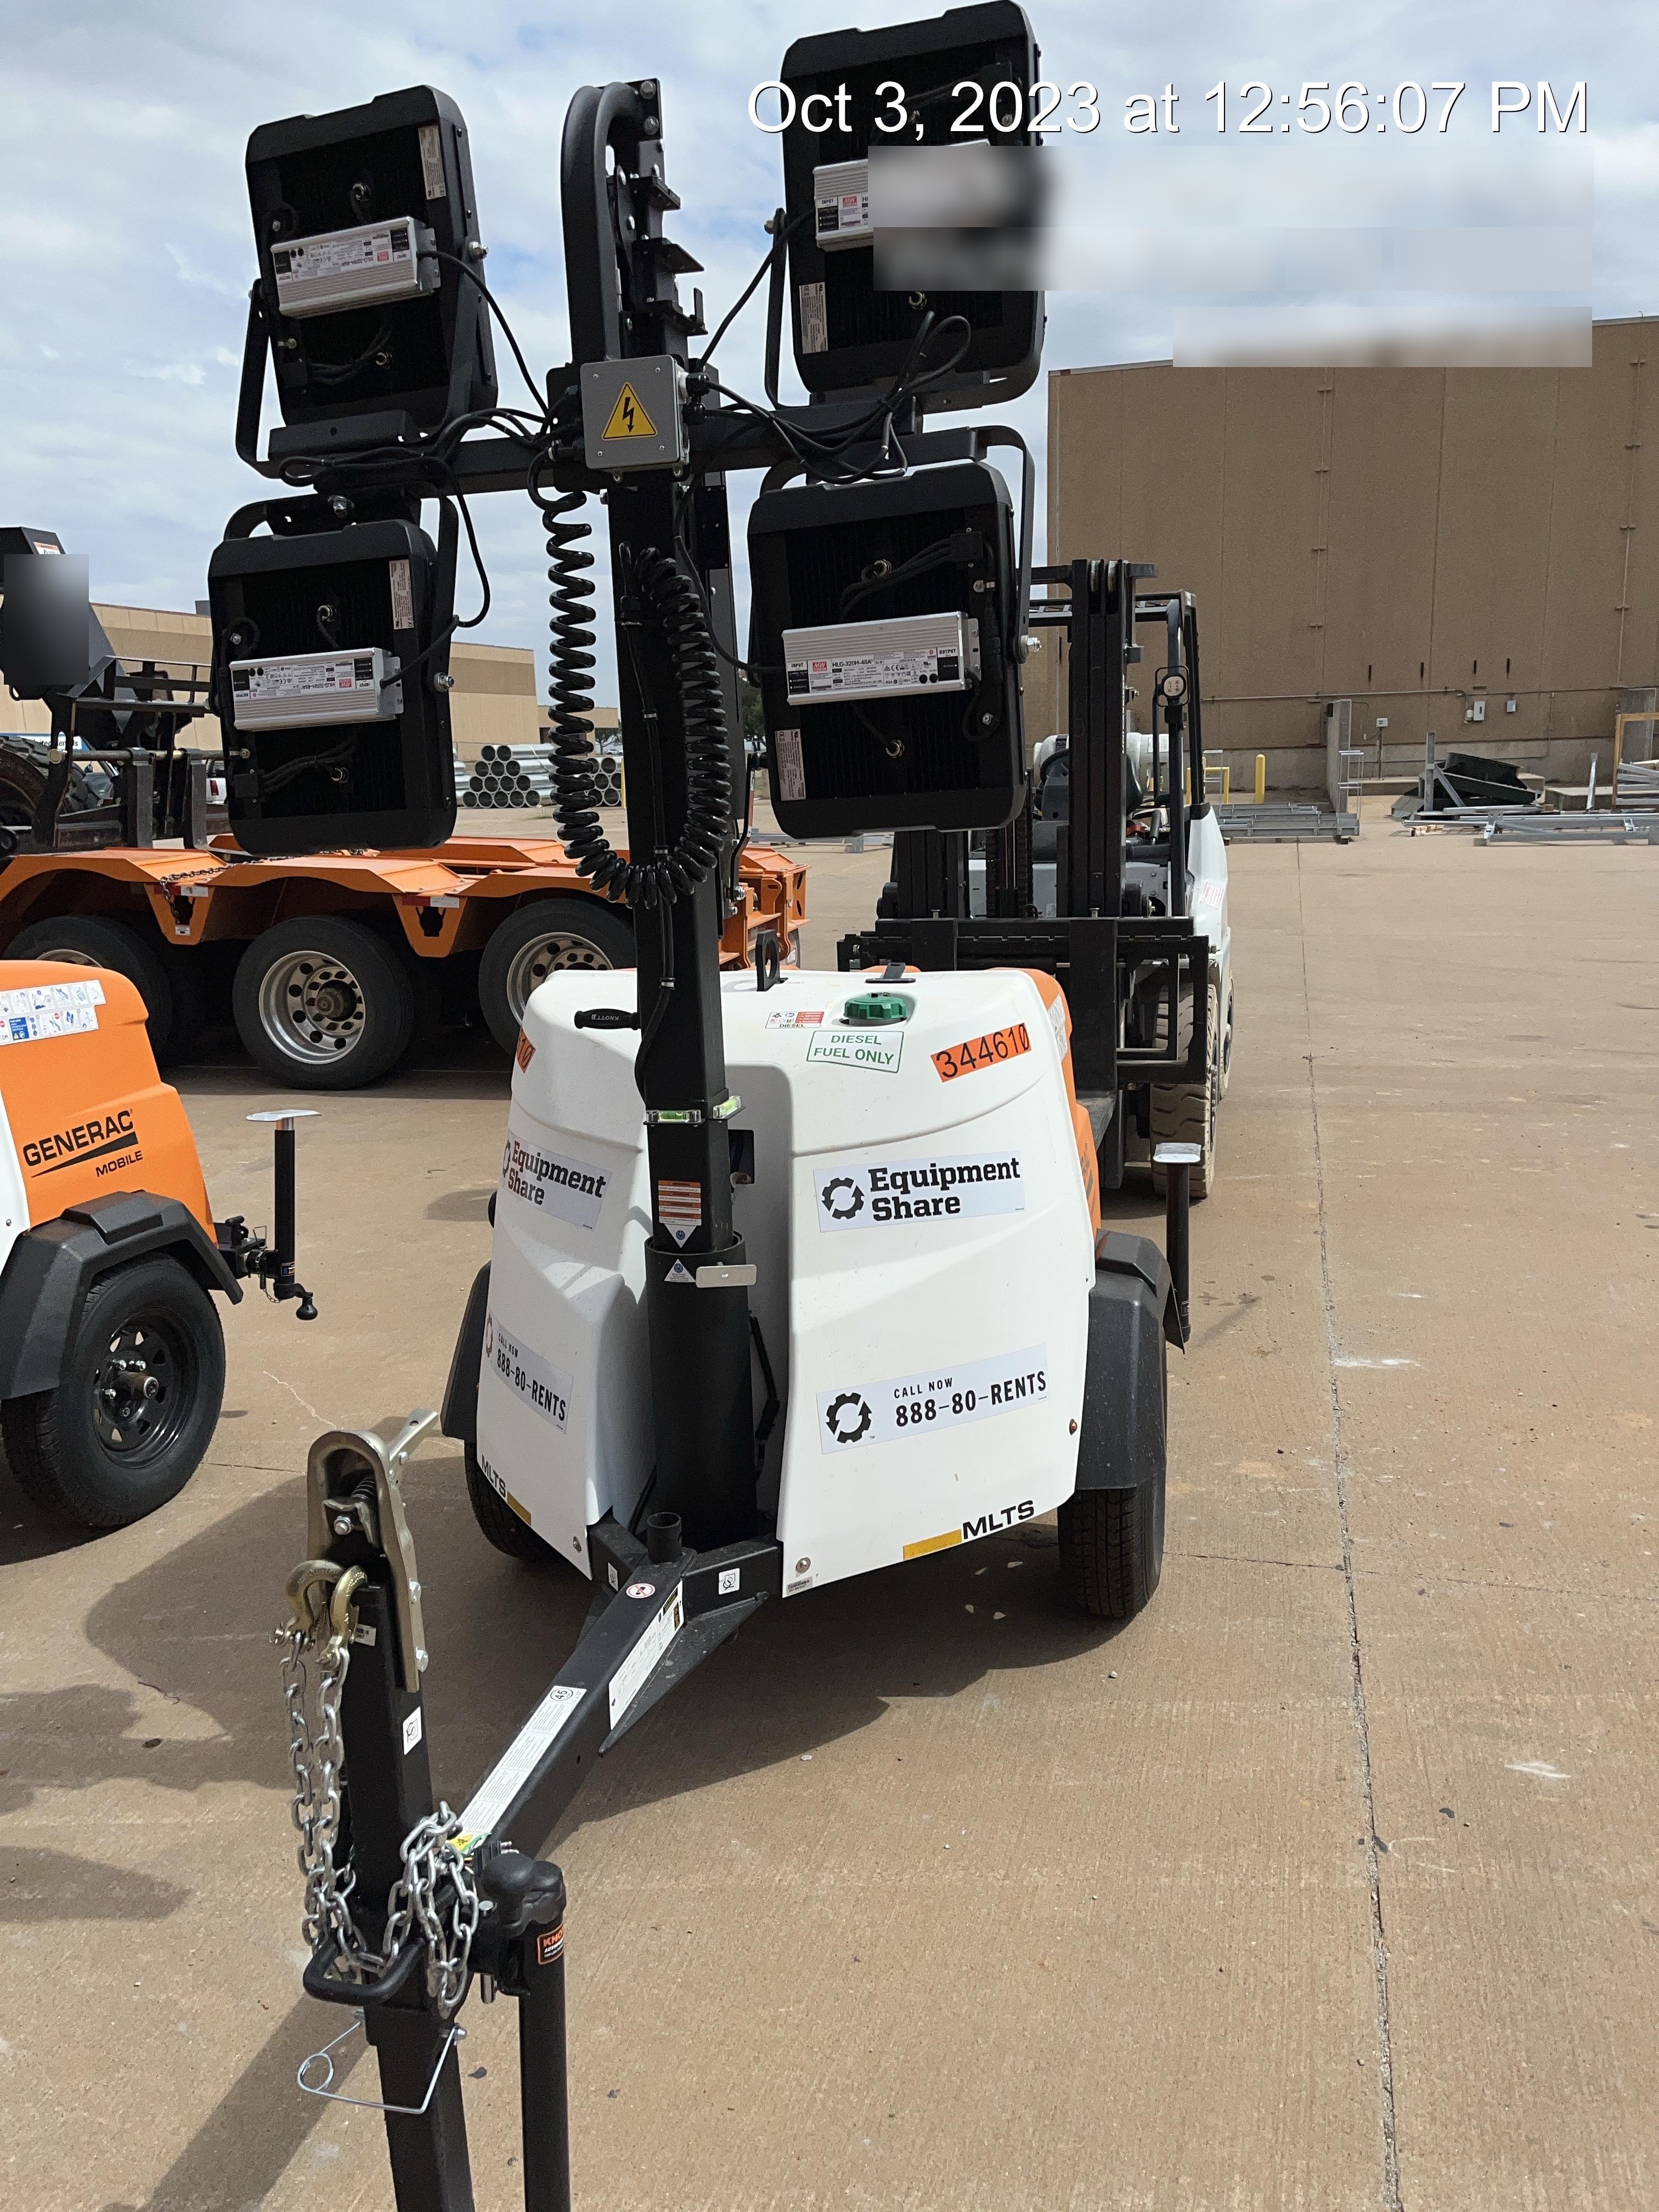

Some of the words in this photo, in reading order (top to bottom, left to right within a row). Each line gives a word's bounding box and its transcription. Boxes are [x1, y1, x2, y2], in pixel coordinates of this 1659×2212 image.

[814, 1048, 850, 1059] FUEL
[855, 1049, 894, 1065] ONLY
[831, 1035, 882, 1045] DIESEL
[936, 1023, 1030, 1078] 344610
[23, 1110, 134, 1166] GENERAC
[95, 1150, 143, 1177] MOBILE
[512, 1140, 606, 1198] Equipment
[868, 1158, 1020, 1195] Equipment
[508, 1167, 545, 1205] Share
[872, 1196, 961, 1221] Share
[498, 1333, 507, 1349] CALL
[509, 1343, 518, 1358] NOW
[497, 1348, 566, 1421] 888-80-RENTS
[894, 1384, 923, 1399] CALL
[928, 1377, 953, 1392] NOW
[895, 1370, 1047, 1427] 888-80-RENTS
[482, 1454, 506, 1498] MLTS
[963, 1500, 1035, 1539] MLTS
[555, 1690, 568, 1700] 45
